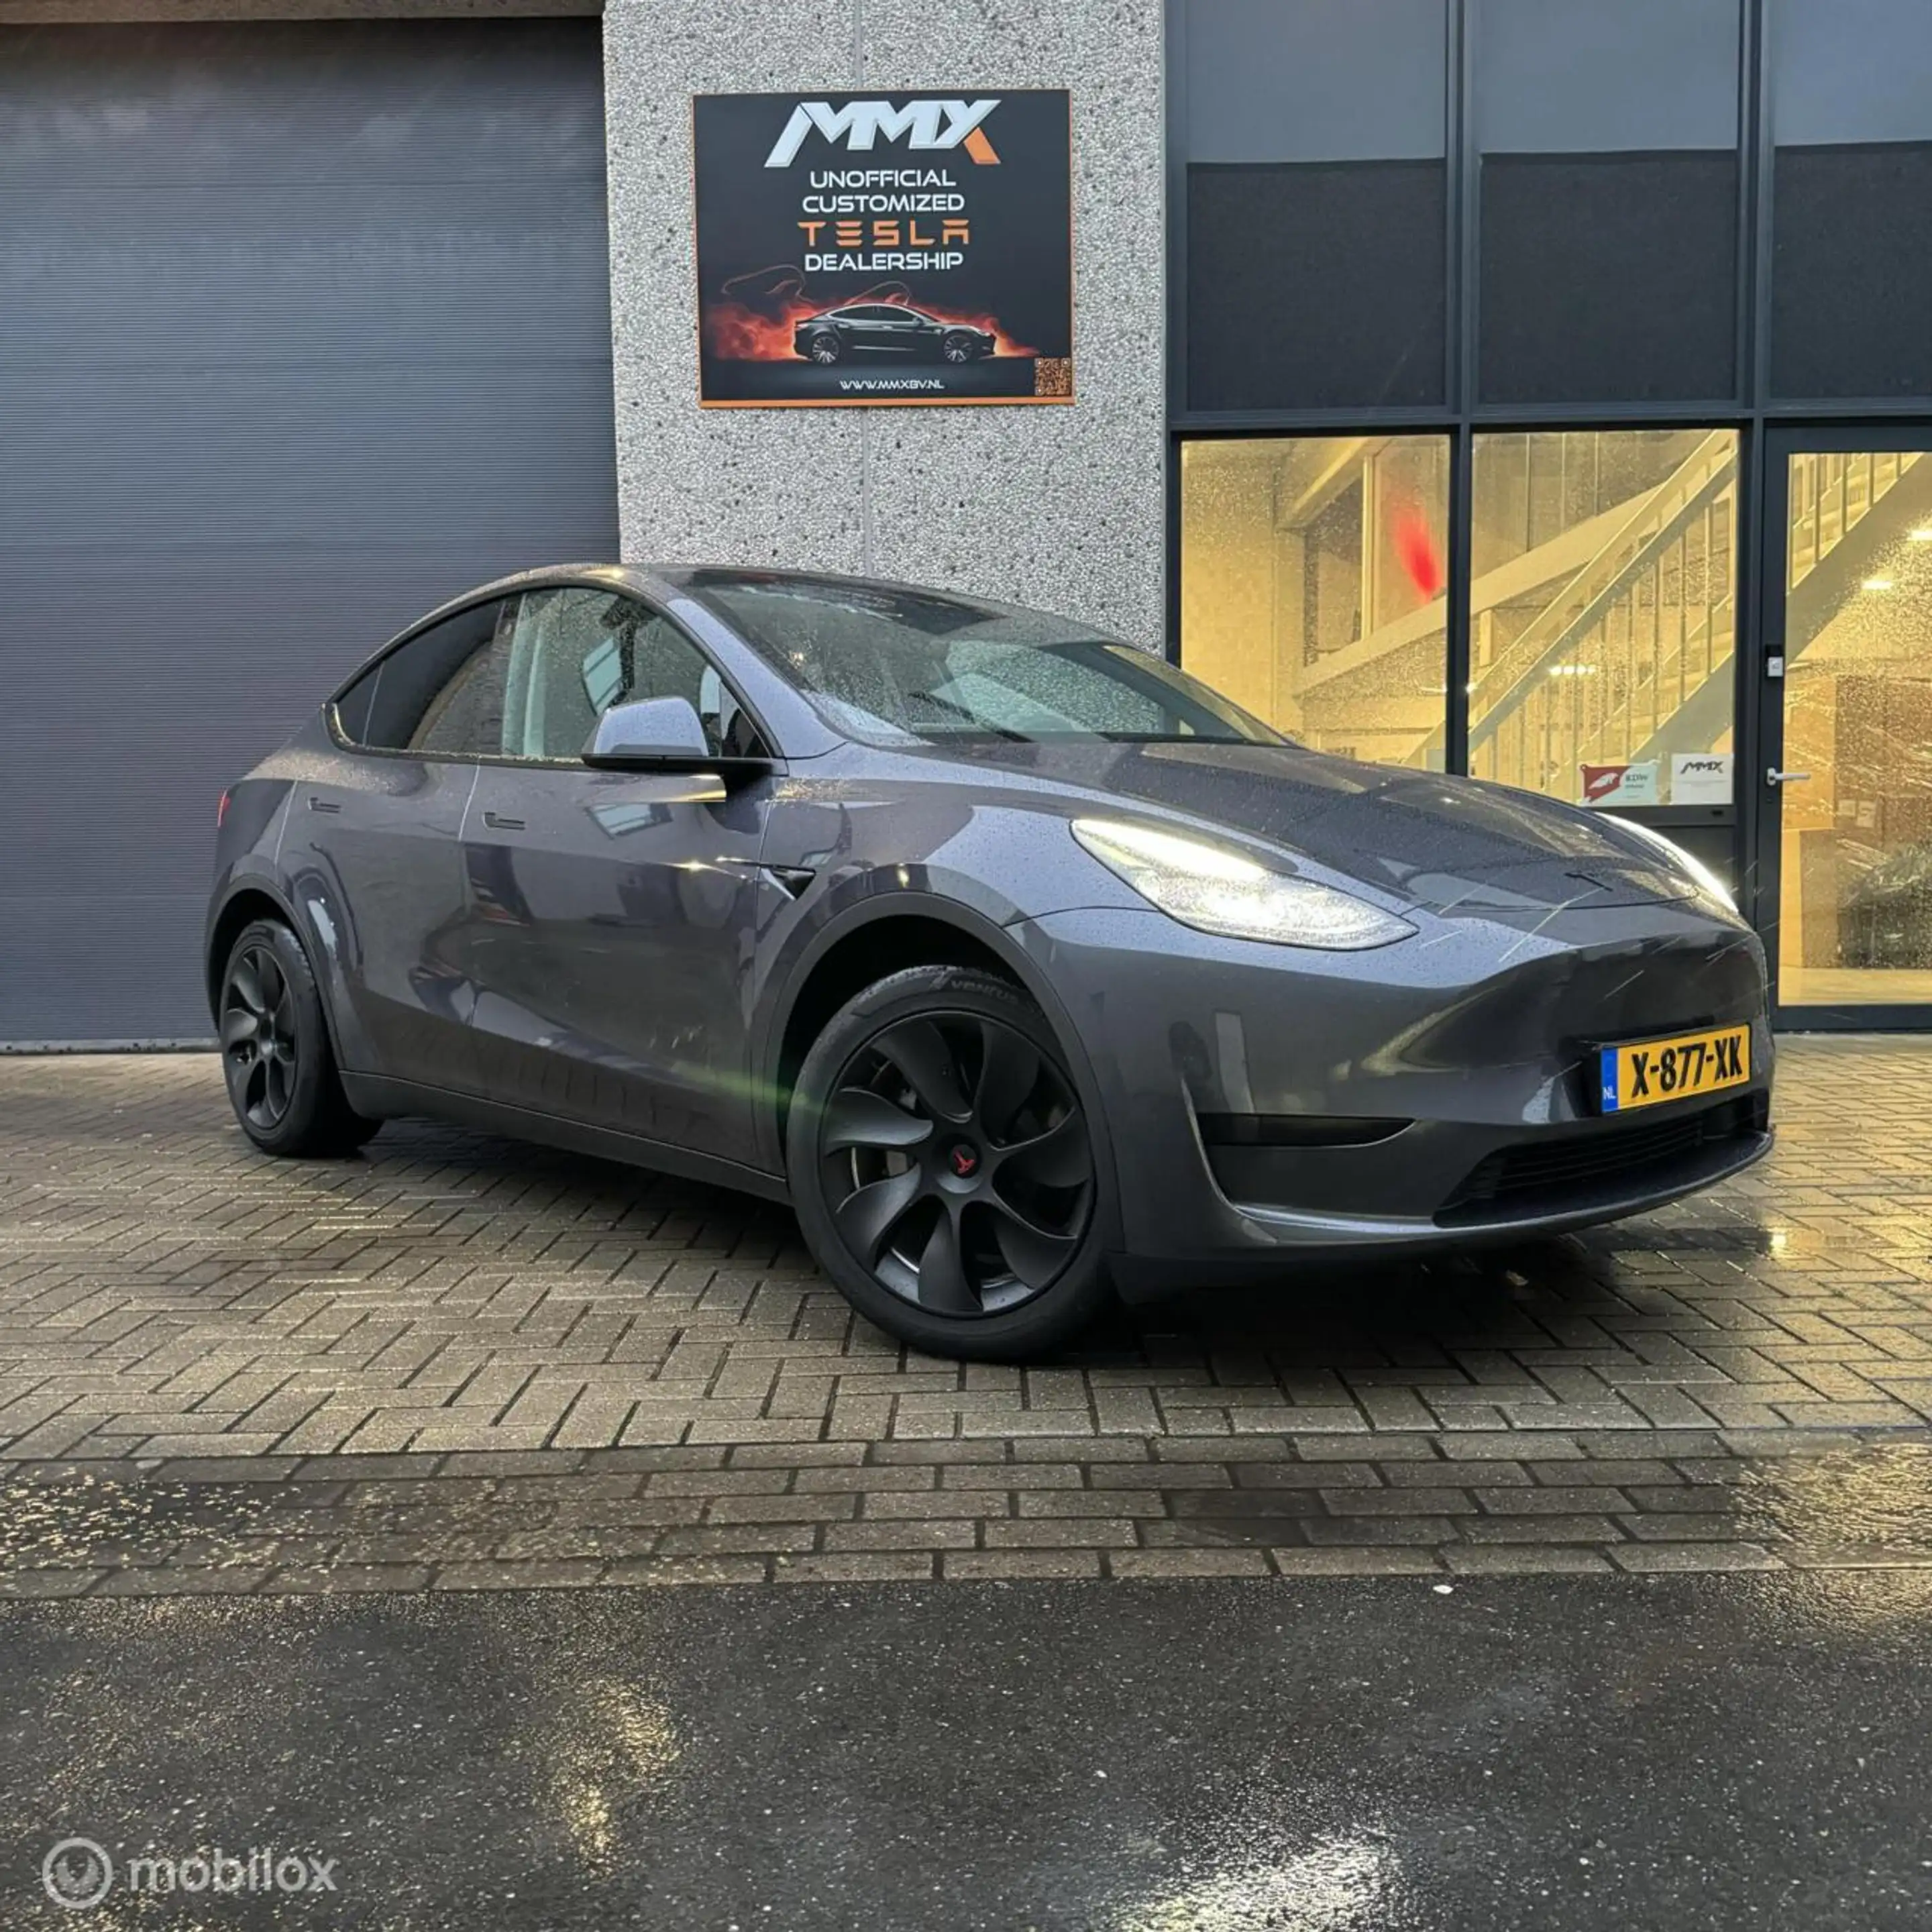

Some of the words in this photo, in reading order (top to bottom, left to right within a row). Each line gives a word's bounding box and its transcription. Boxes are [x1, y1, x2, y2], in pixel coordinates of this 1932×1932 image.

[764, 99, 1002, 168] MMX
[810, 169, 956, 188] UNOFFICIAL
[802, 194, 965, 213] CUSTOMIZED
[797, 219, 969, 247] TESLA
[805, 252, 963, 272] DEALERSHIP
[1631, 1035, 1743, 1099] X-877-XK
[1602, 1086, 1616, 1099] NL
